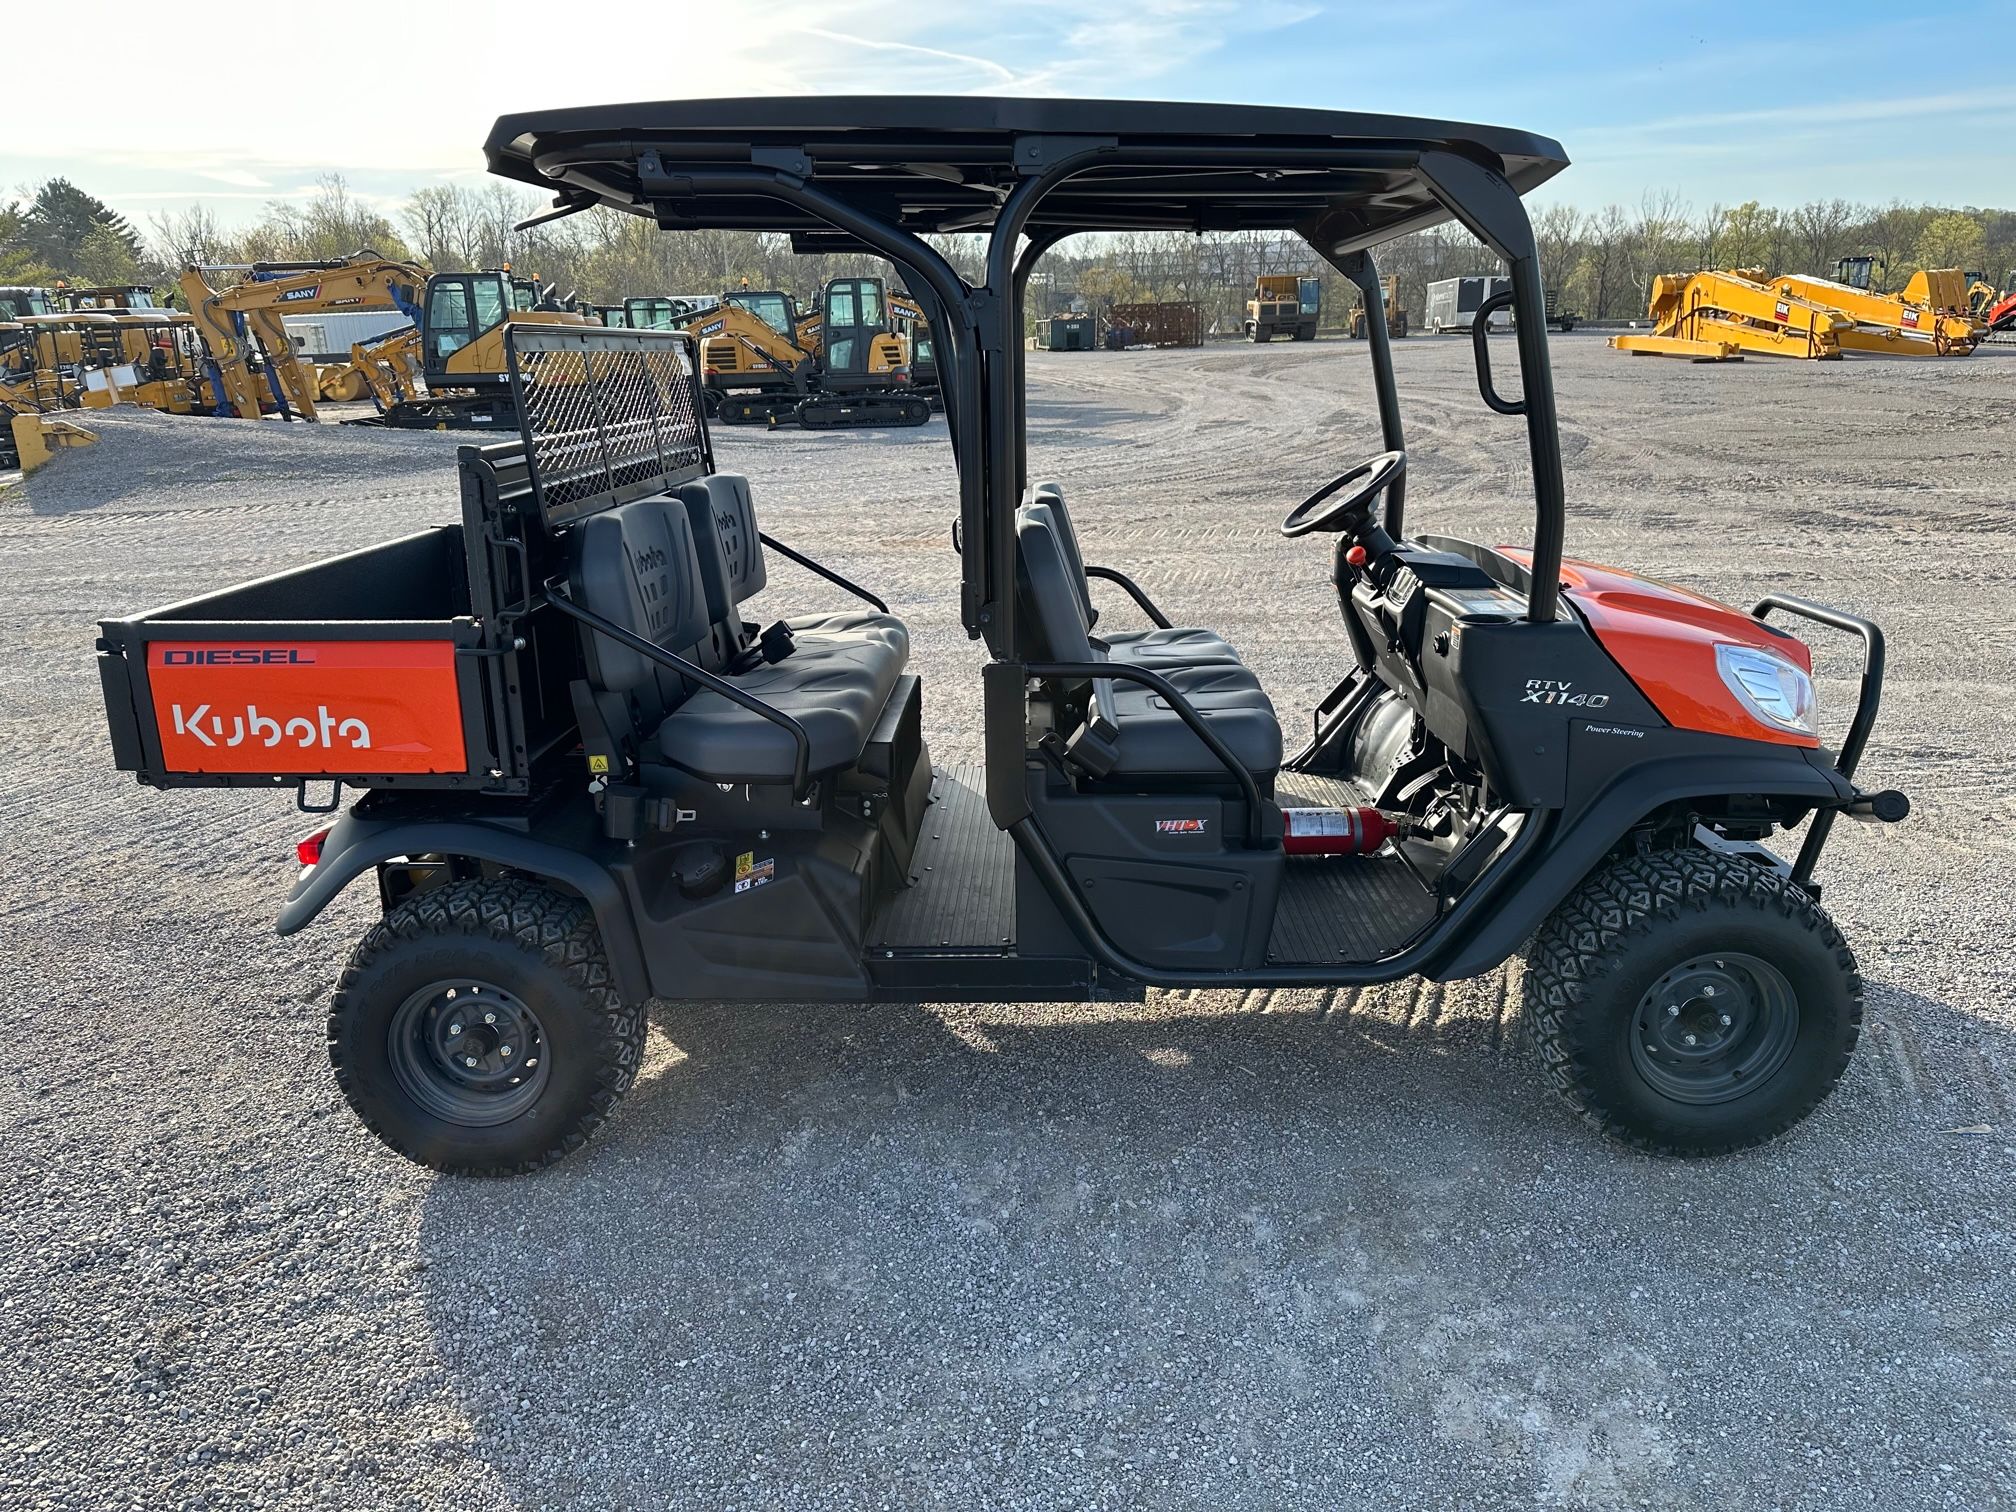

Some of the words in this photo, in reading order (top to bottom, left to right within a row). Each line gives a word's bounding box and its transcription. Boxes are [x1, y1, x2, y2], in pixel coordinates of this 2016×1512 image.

[286, 289, 315, 300] SANY
[893, 305, 917, 318] SANY
[1776, 302, 1790, 315] EIK
[1903, 310, 1920, 322] EIK
[701, 322, 722, 335] SANY
[807, 324, 822, 334] SAN
[164, 650, 316, 665] DIESEL
[1525, 679, 1572, 691] RTV
[1519, 690, 1610, 708] X1140
[172, 704, 371, 749] Kubota
[1585, 725, 1612, 734] Power
[1611, 727, 1645, 738] Steering
